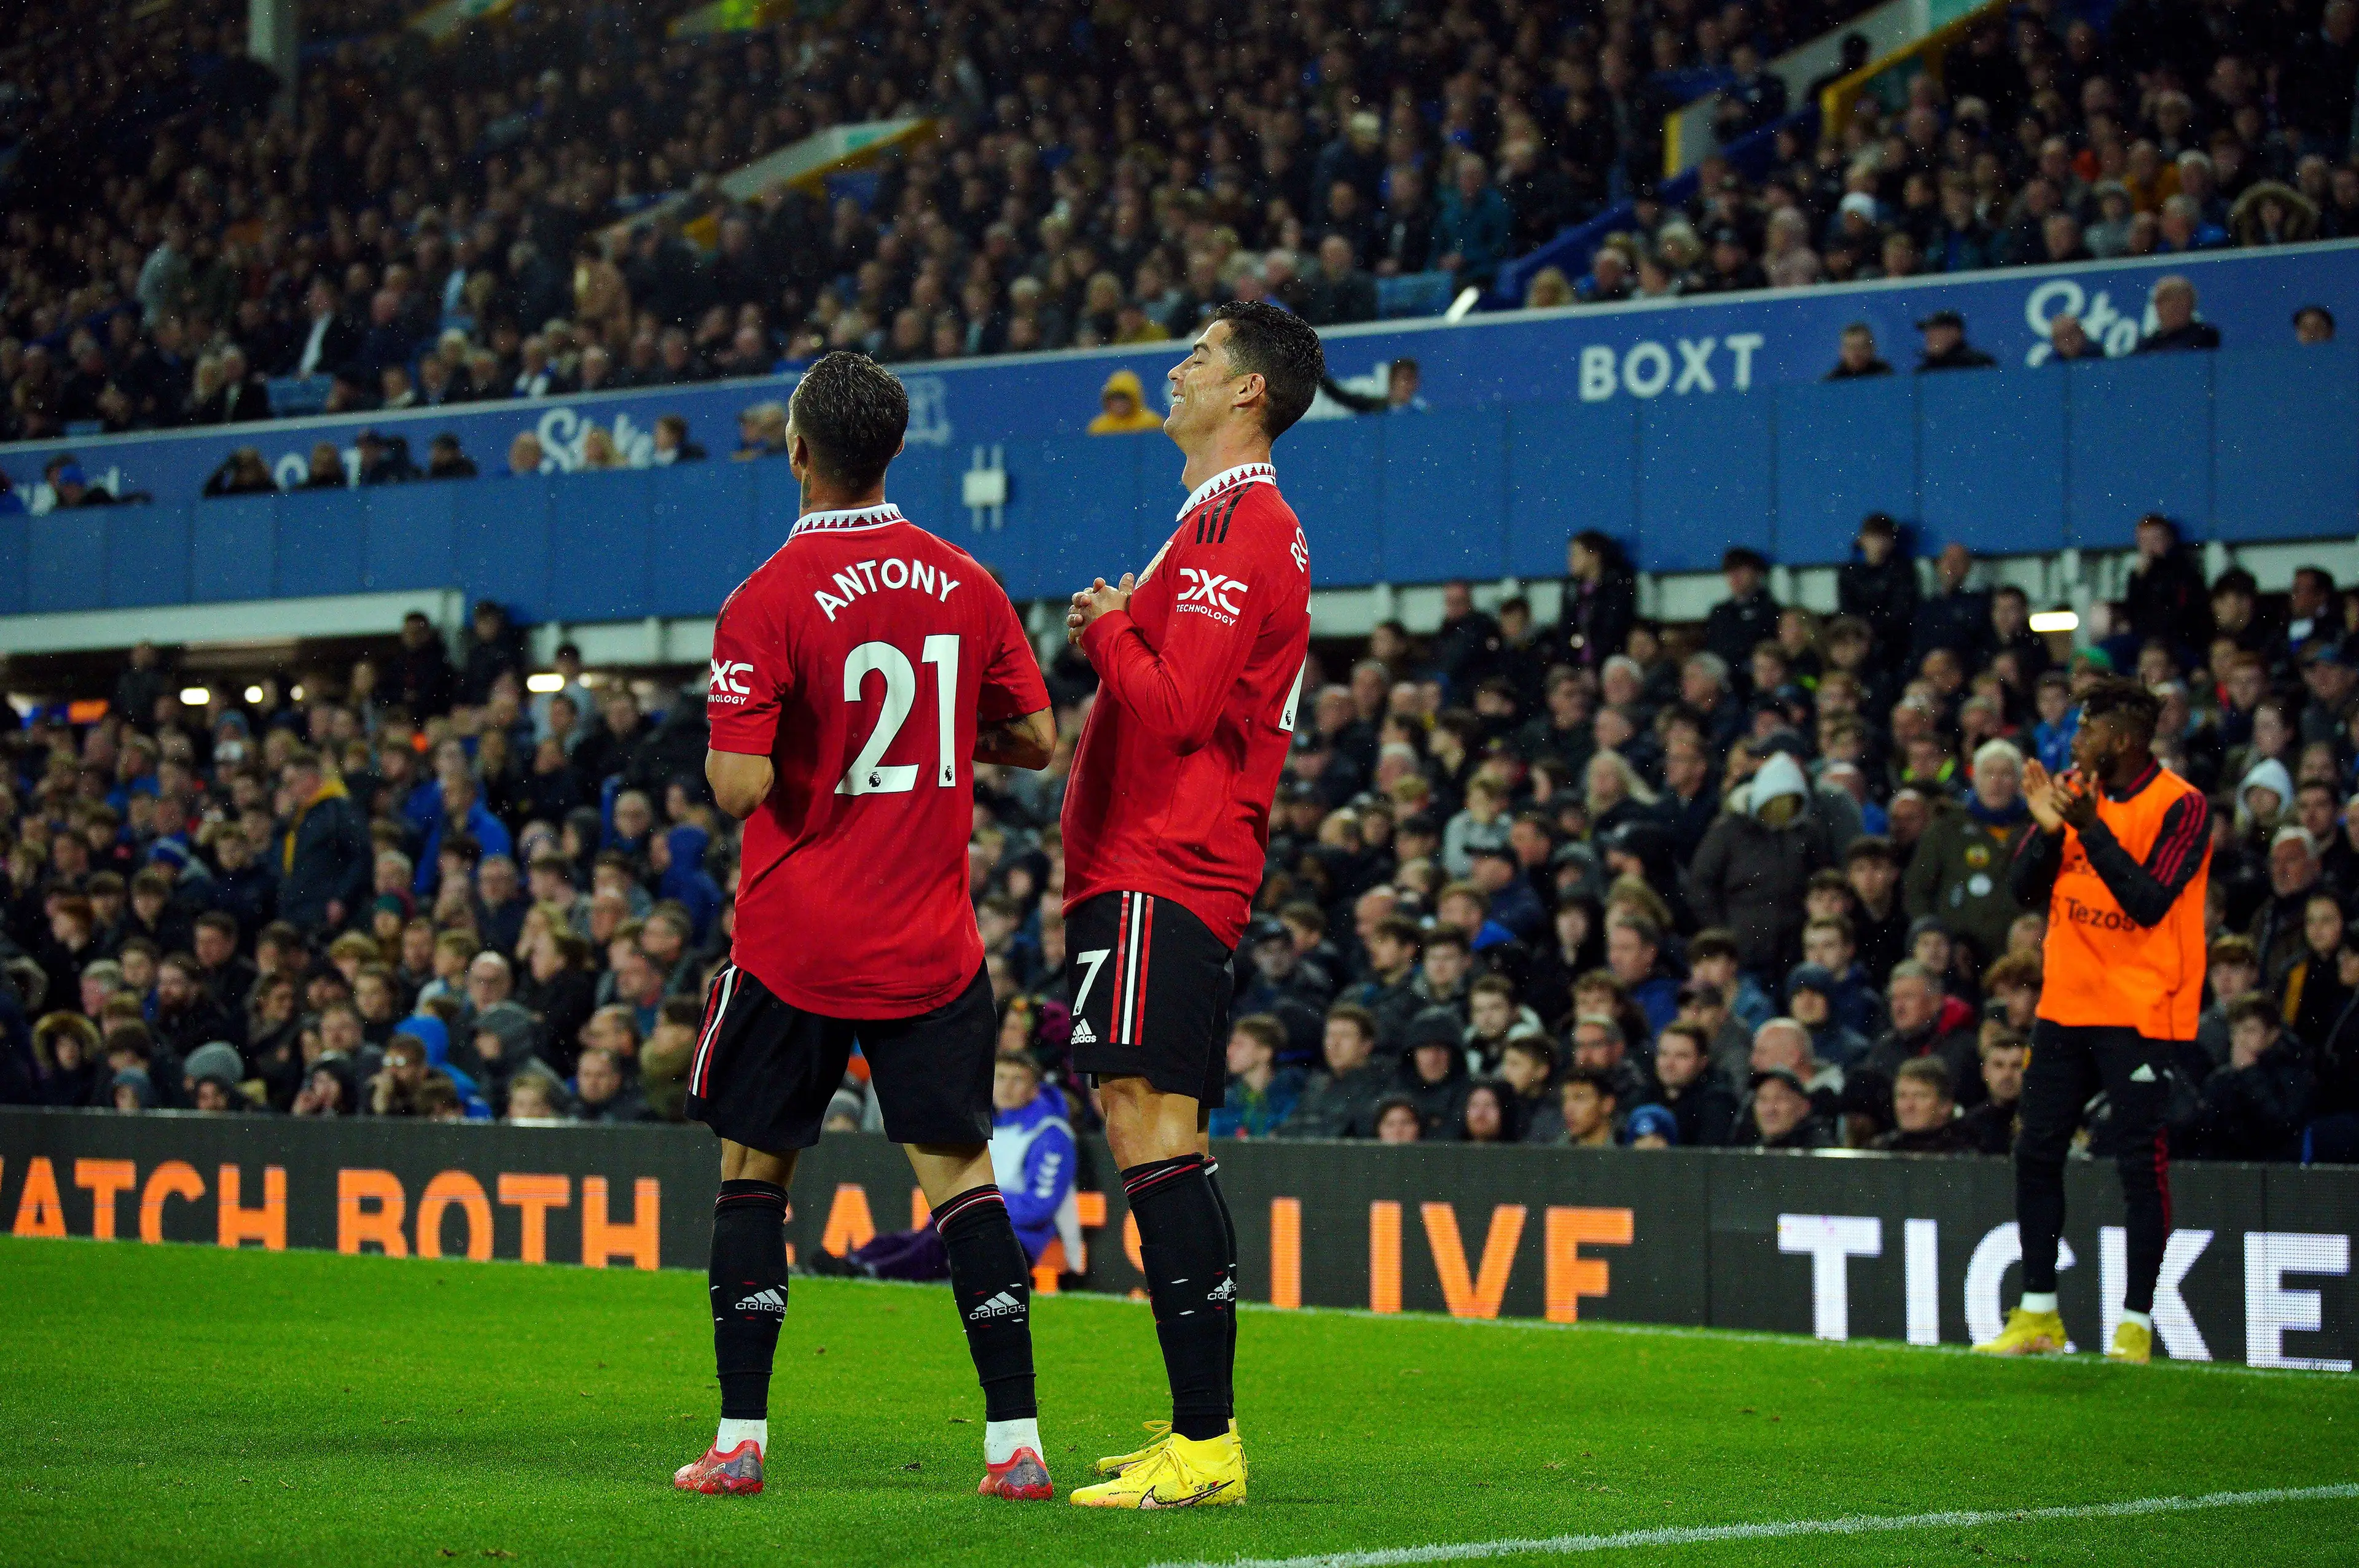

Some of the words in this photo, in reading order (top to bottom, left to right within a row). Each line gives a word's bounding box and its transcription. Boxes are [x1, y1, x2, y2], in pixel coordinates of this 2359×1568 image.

[1579, 333, 1763, 402] BOXT
[814, 558, 961, 622] ANTONY
[1176, 604, 1236, 626] TECHNOLOGY
[1177, 568, 1248, 616] DXC
[834, 634, 960, 796] 21
[1072, 948, 1111, 1016] 7
[1071, 1034, 1097, 1045] adidas
[0, 1156, 288, 1251] ATCH
[337, 1169, 660, 1271] BOTH
[735, 1300, 788, 1314] adidas
[969, 1303, 1027, 1320] adidas
